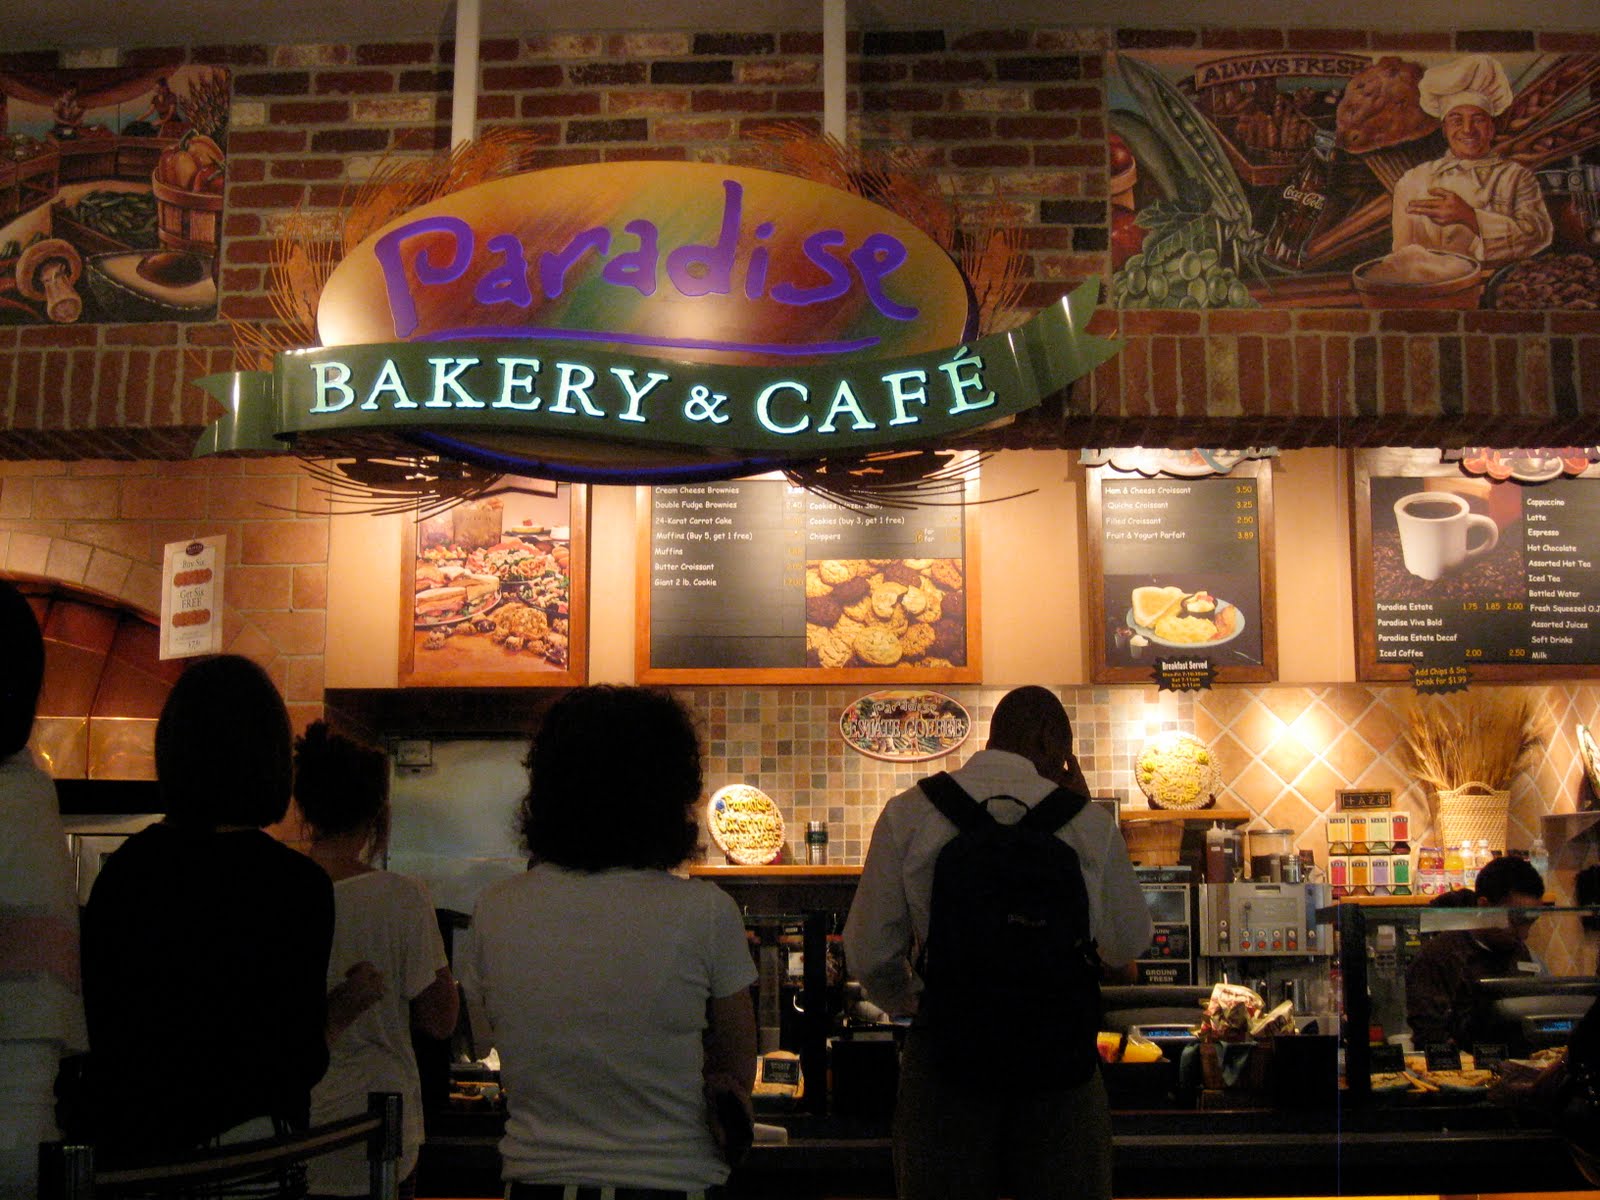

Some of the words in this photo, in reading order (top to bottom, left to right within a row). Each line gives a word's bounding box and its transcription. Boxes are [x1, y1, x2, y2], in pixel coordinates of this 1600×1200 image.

[1203, 58, 1290, 83] ALWAYS
[374, 179, 921, 338] Paradise
[308, 357, 670, 424] BAKERY
[683, 384, 730, 424] &
[756, 345, 997, 435] CAFÉ
[655, 486, 679, 494] Cream
[680, 486, 706, 494] Cheese
[707, 486, 740, 494] Brownies
[1105, 486, 1121, 495] Ham
[1130, 486, 1156, 495] Cheese
[1158, 486, 1192, 495] Croissant
[1235, 486, 1253, 494] 3.50
[655, 501, 680, 509] Double
[681, 501, 704, 511] Fudge
[705, 501, 738, 509] Brownies
[809, 502, 837, 510] Cookies
[1107, 502, 1133, 510] Quiche
[1135, 501, 1169, 509] Croissant
[1235, 501, 1253, 509] 3.25
[1526, 498, 1566, 508] Cappuccino
[655, 517, 688, 525] 24-Karat
[689, 517, 713, 525] Carrot
[714, 517, 733, 525] Cake
[809, 517, 837, 525] Cookies
[838, 516, 855, 526] (buy
[865, 517, 878, 526] get
[885, 516, 905, 525] free)
[1105, 517, 1126, 525] Filled
[1127, 517, 1162, 525] Croissant
[1236, 516, 1254, 524] 2.50
[1526, 514, 1547, 522] Latte
[656, 532, 685, 540] Muffins
[686, 532, 702, 541] (Buy
[713, 533, 726, 541] get
[733, 532, 753, 540] free)
[809, 533, 841, 542] Chippers
[1106, 531, 1126, 540] Fruit
[1127, 532, 1133, 540] &
[1134, 531, 1158, 542] Yogurt
[1160, 531, 1186, 540] Parfait
[1527, 528, 1560, 538] Espresso
[654, 548, 684, 556] Muffins
[1527, 544, 1541, 552] Hot
[1542, 544, 1577, 552] Chocolate
[182, 559, 194, 569] Buy
[654, 563, 679, 571] Butter
[680, 563, 715, 571] Croissant
[1528, 560, 1561, 568] Assorted
[1562, 560, 1577, 568] Hot
[1578, 560, 1592, 568] Tea
[654, 578, 674, 586] Giant
[682, 578, 691, 586] lb.
[693, 578, 717, 586] Cookie
[1528, 574, 1546, 582] Iced
[1547, 574, 1561, 582] Tea
[180, 588, 193, 600] Get
[194, 586, 205, 597] Six
[1528, 589, 1556, 598] Bottled
[1557, 590, 1580, 598] Water
[181, 598, 202, 609] FREE
[1377, 603, 1408, 611] Paradise
[1409, 603, 1433, 611] Estate
[1462, 602, 1479, 610] 1.75
[1485, 602, 1501, 610] 1.85
[1507, 602, 1524, 610] 2.00
[1530, 604, 1551, 612] Fresh
[1552, 604, 1586, 614] Squeezed
[1377, 618, 1408, 627] Paradise
[1410, 618, 1426, 627] Viva
[1426, 618, 1443, 627] Bold
[1565, 621, 1589, 629] Juices
[1378, 634, 1409, 642] Paradise
[1410, 634, 1435, 642] Estate
[1436, 634, 1458, 642] Decaf
[1531, 636, 1548, 644] Soft
[1549, 636, 1574, 644] Drinks
[1379, 649, 1397, 657] Iced
[1398, 649, 1424, 657] Coffee
[1465, 649, 1482, 657] 2.00
[1509, 649, 1526, 657] 2.50
[1531, 651, 1548, 660] Milk
[1161, 660, 1188, 671] Breakfast
[1189, 660, 1208, 670] Served
[1415, 668, 1429, 676] Add
[1430, 667, 1448, 677] Chips
[1416, 678, 1435, 687] Drink
[1436, 677, 1447, 685] for
[871, 697, 940, 716] Paradise
[849, 718, 901, 738] ESTATE
[904, 718, 966, 738] COFFEE
